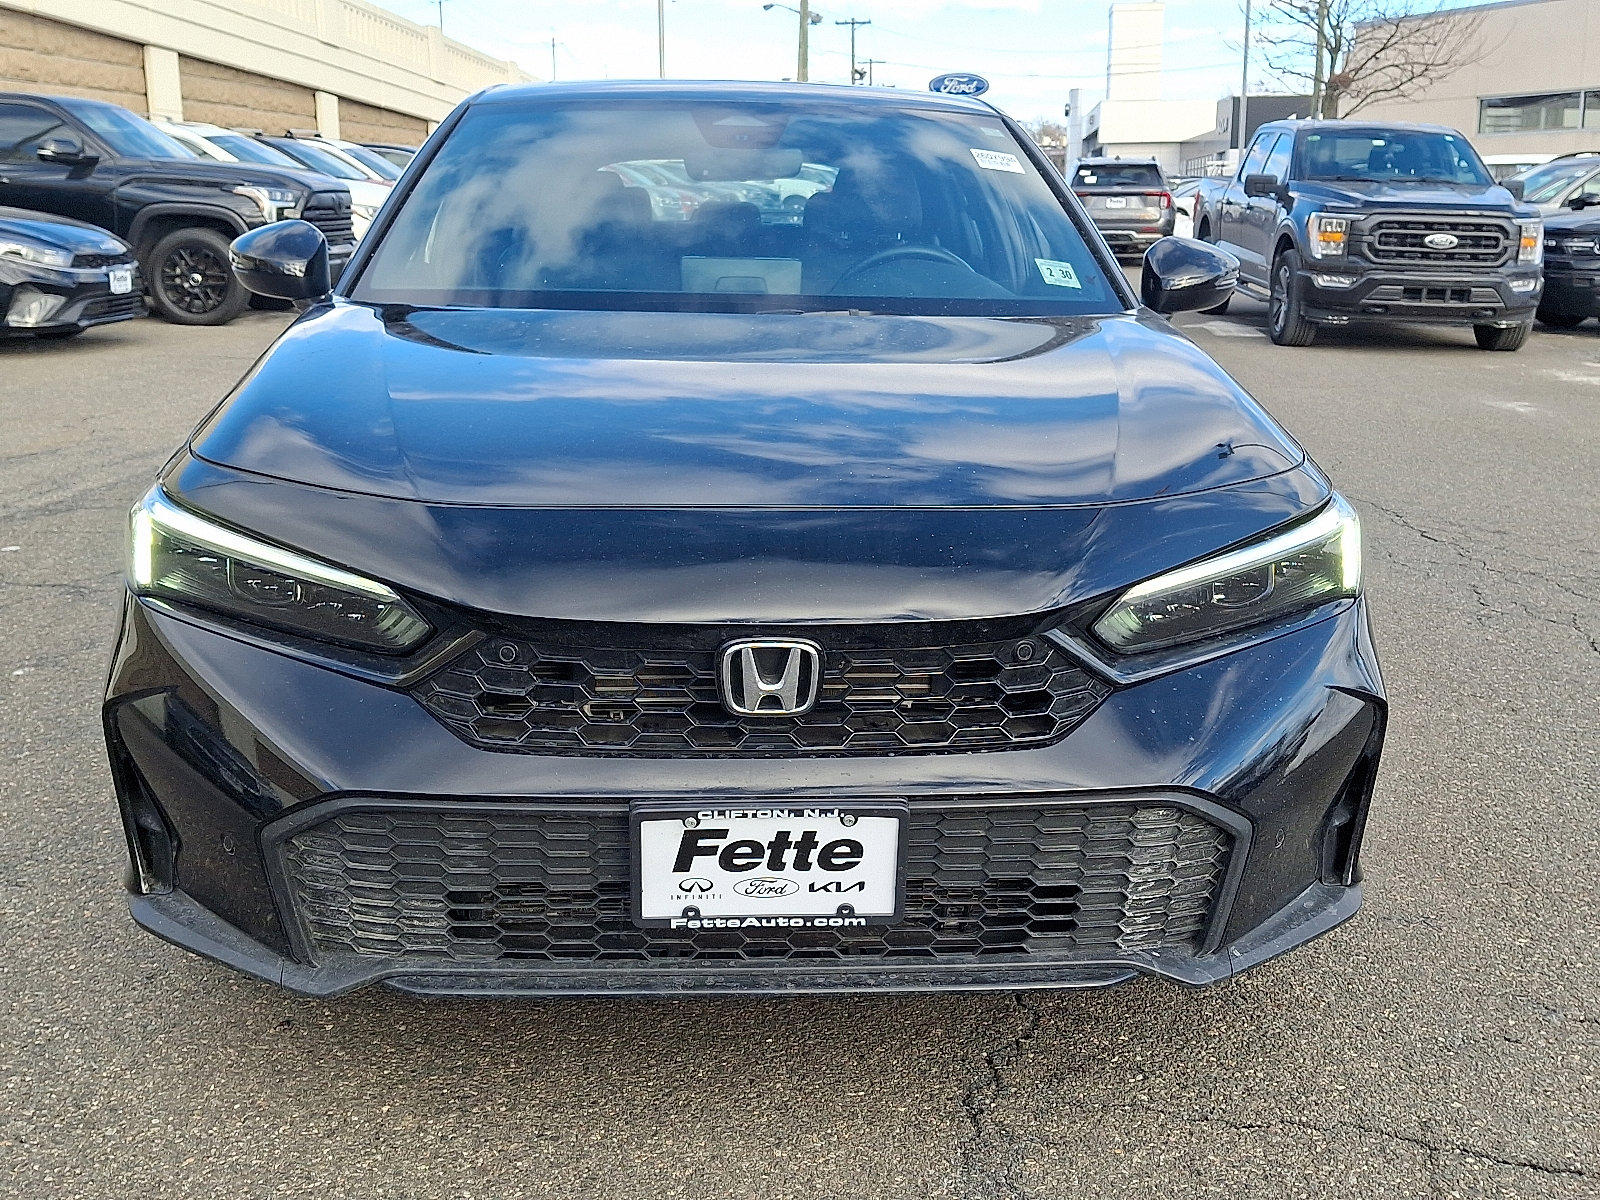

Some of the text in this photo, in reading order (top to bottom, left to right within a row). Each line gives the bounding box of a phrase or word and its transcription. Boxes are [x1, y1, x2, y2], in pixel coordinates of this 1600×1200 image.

[940, 77, 978, 93] Ford
[1046, 267, 1073, 280] 2 30
[671, 828, 864, 873] Fette
[743, 879, 788, 896] Ford
[808, 881, 866, 893] KIA
[670, 893, 723, 901] INFINITI
[670, 916, 866, 929] FetteAuto.com
